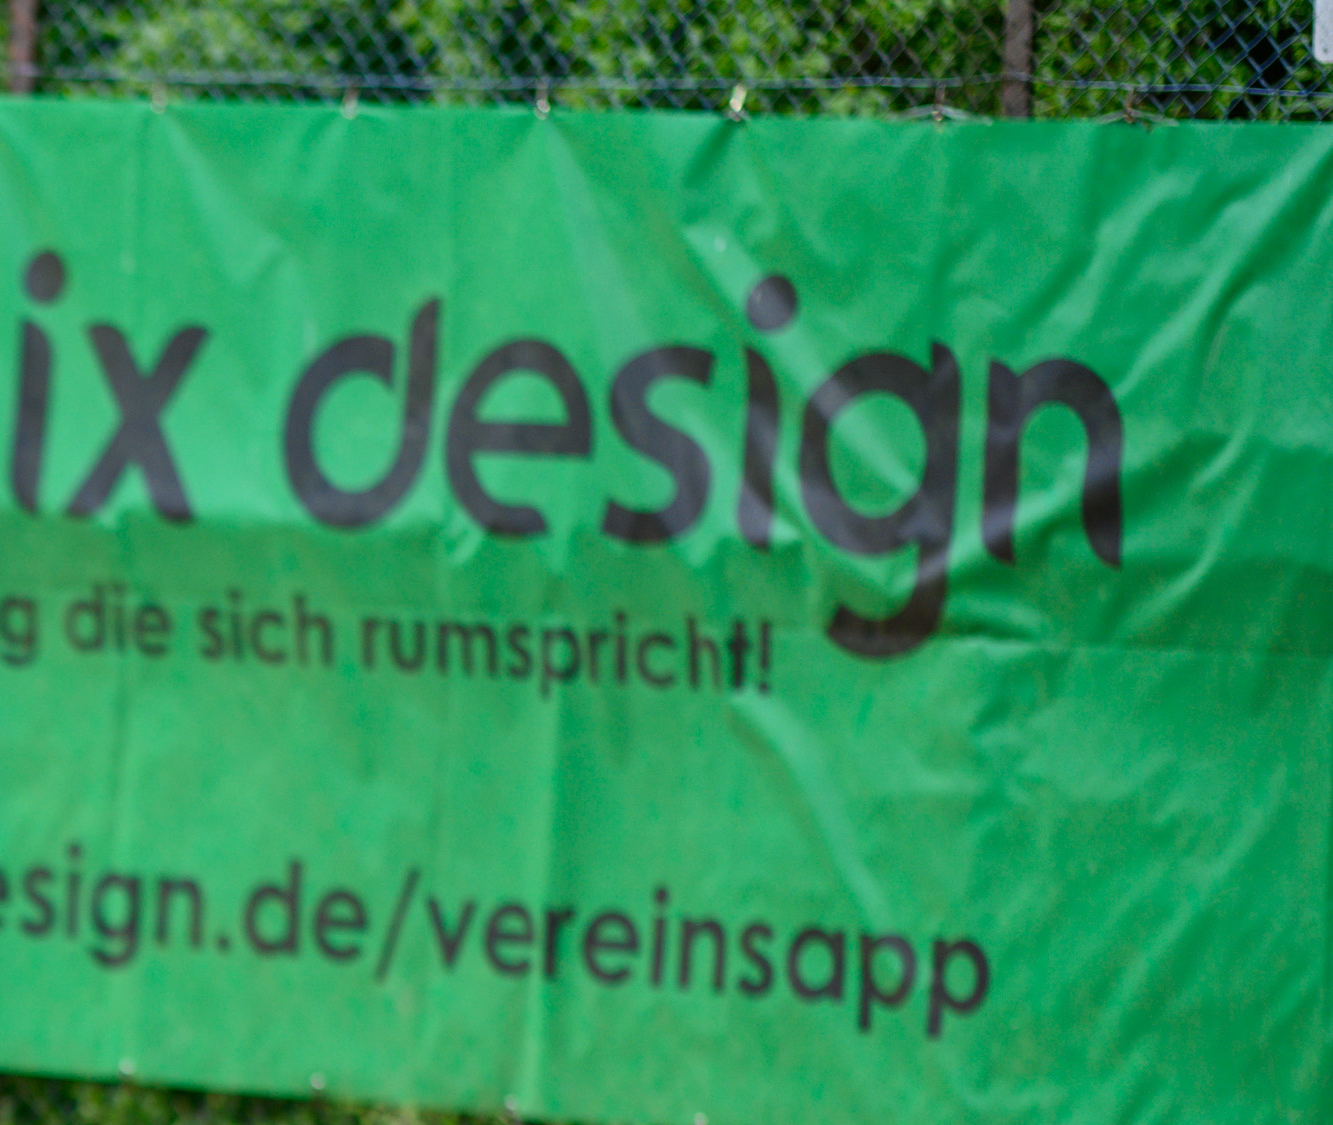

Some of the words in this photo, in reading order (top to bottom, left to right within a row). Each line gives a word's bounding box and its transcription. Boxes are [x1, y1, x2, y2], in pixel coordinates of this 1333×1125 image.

[281, 273, 1126, 660] design
[62, 582, 171, 658] die
[198, 591, 333, 666] sich
[360, 610, 772, 695] rumspricht!
